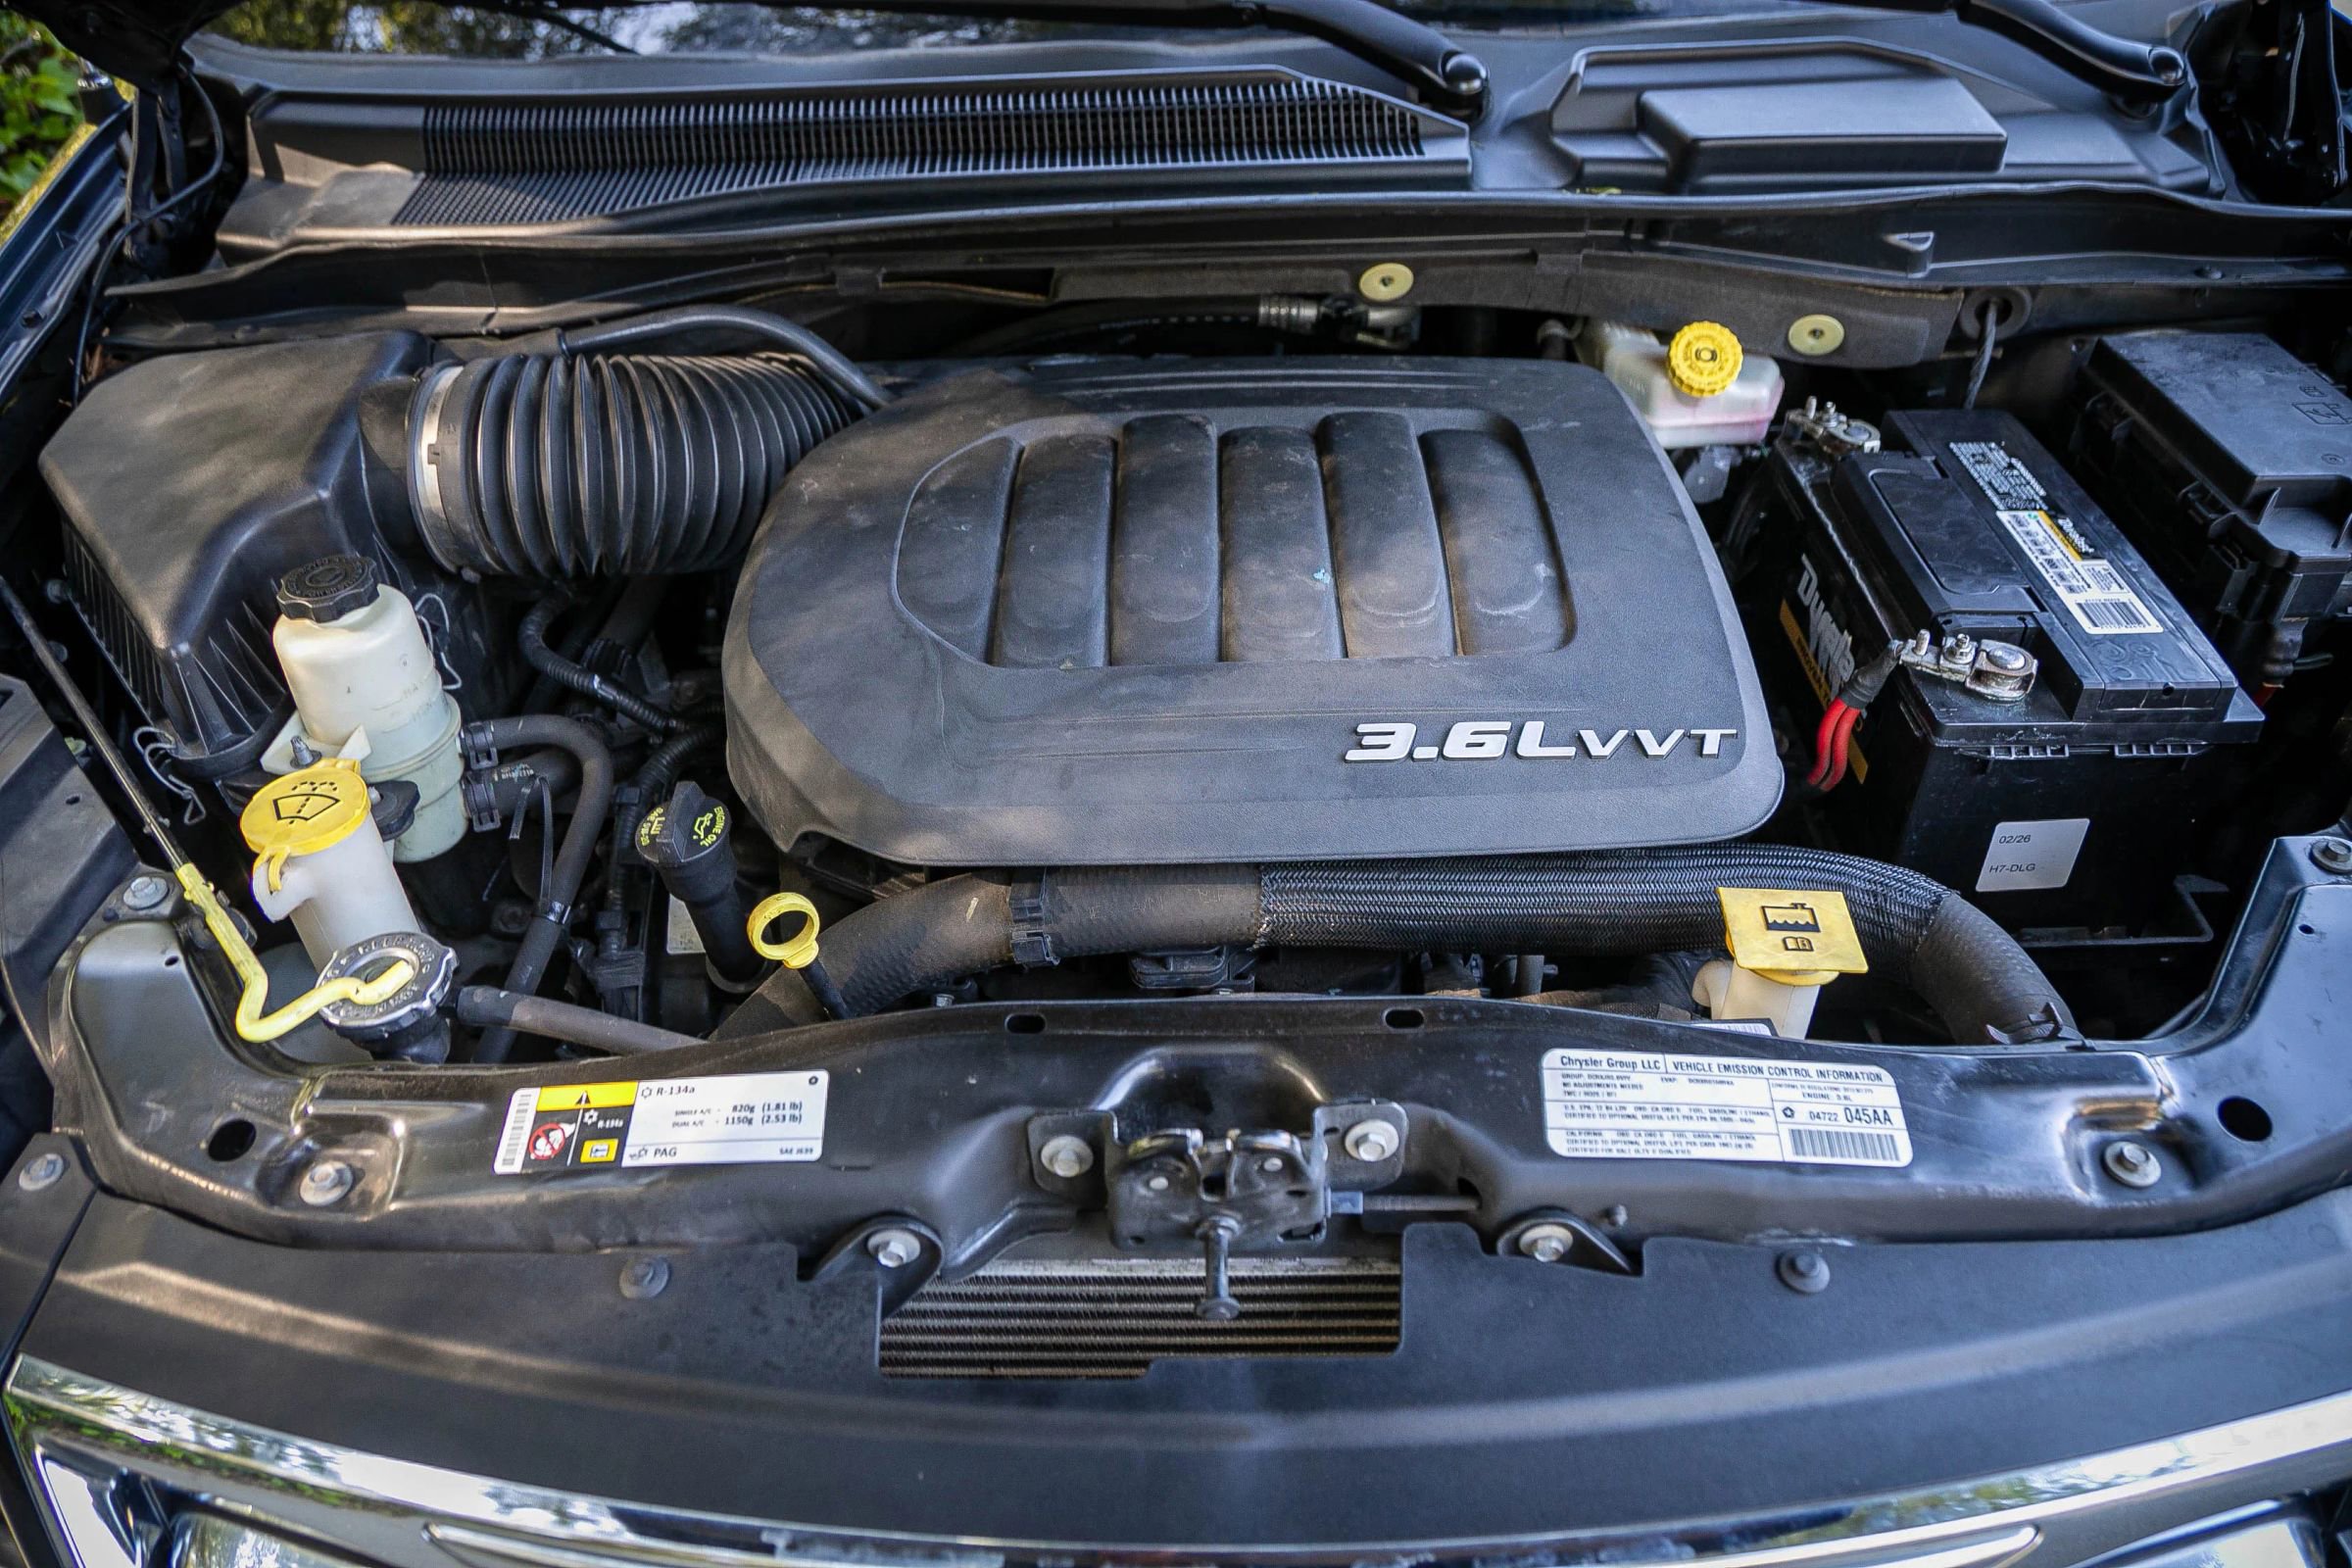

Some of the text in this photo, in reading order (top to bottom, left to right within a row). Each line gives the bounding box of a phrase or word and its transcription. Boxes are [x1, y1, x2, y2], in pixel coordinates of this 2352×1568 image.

[1577, 728, 1738, 760] VVT
[700, 833, 717, 847] OIL
[1998, 834, 2032, 845] 02/26
[1988, 863, 2036, 873] H7-DLG
[1560, 1055, 1661, 1072] Chrysler Group LLC
[1673, 1060, 1884, 1083] VEHICLE EMISSION CONTROL INFORMATION
[656, 1085, 696, 1097] R-134a
[731, 1104, 756, 1114] 820g
[761, 1102, 786, 1113] (1.81
[789, 1101, 804, 1112] lb)
[724, 1115, 754, 1126] 1150g
[760, 1114, 786, 1126] (2.53
[789, 1113, 803, 1124] lb)
[1809, 1106, 1894, 1126] 04722 045AA
[654, 1147, 678, 1158] PAG
